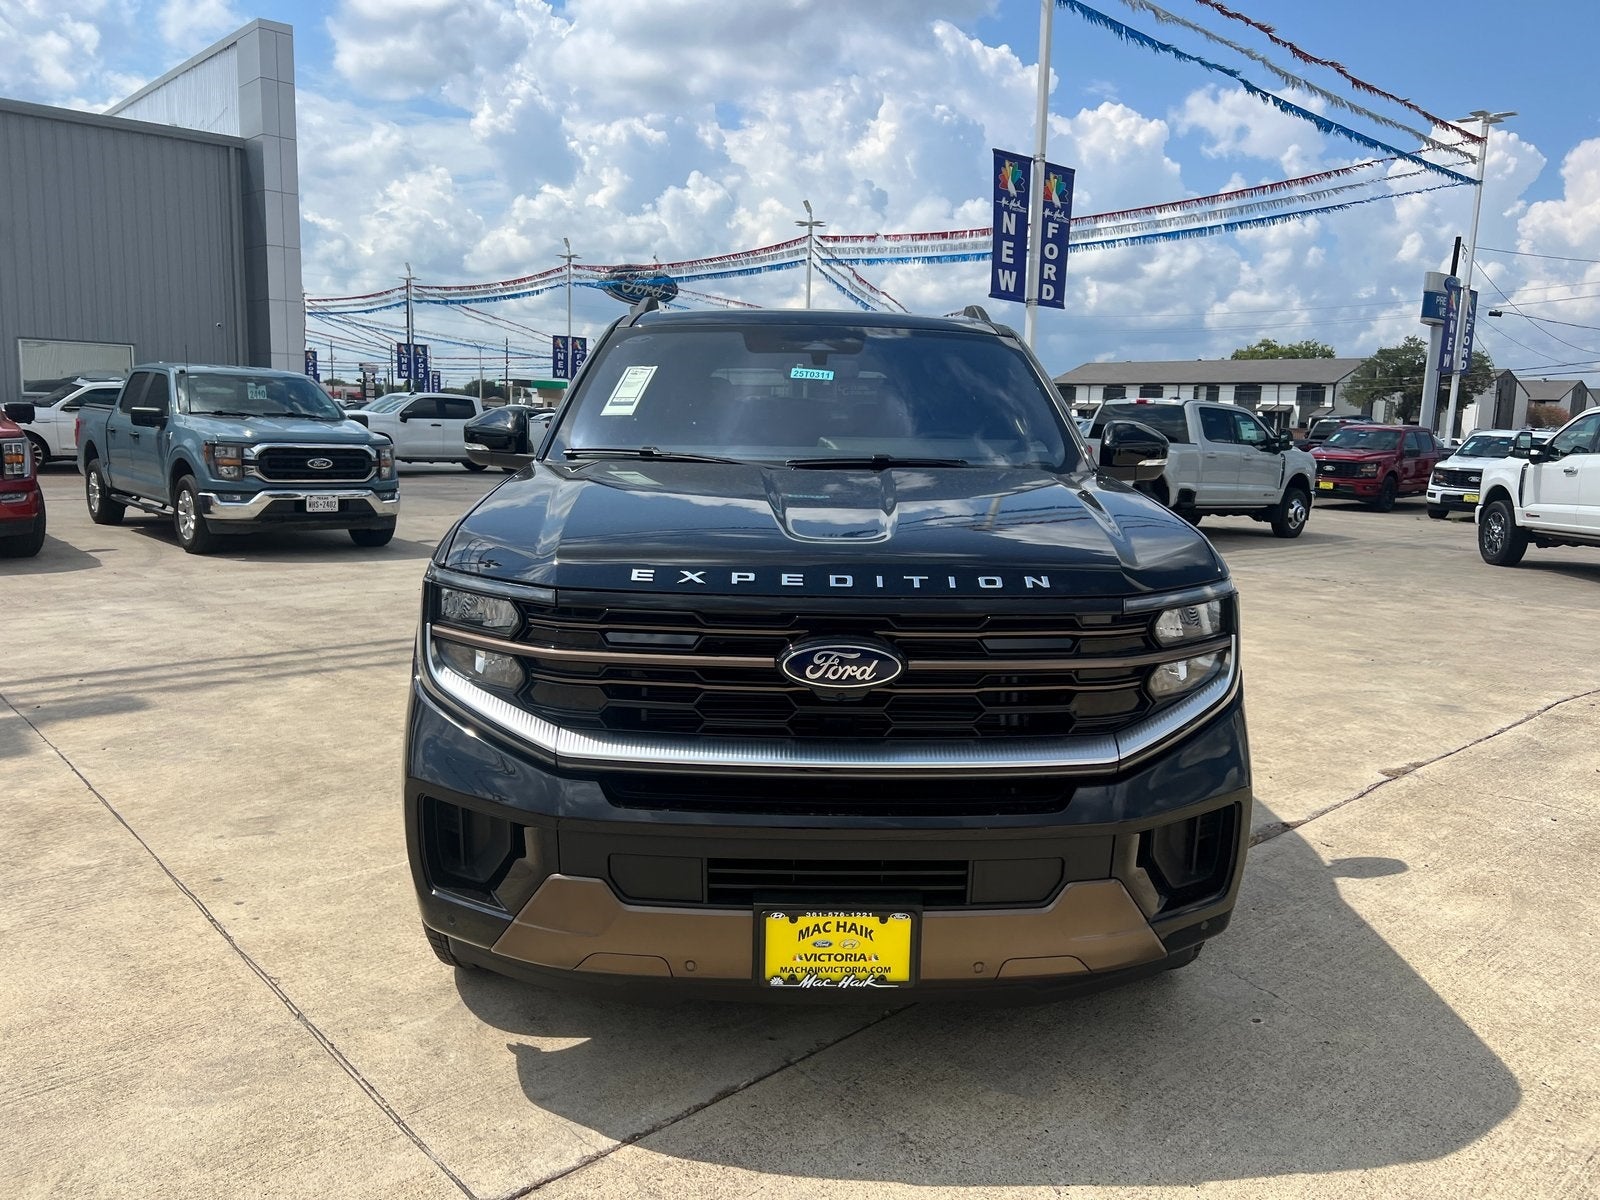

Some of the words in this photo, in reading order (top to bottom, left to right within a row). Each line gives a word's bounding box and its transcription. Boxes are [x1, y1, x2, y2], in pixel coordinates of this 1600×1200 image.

[998, 211, 1017, 292] NEW
[1042, 222, 1058, 300] FORD
[1443, 320, 1456, 368] NEW
[1461, 323, 1471, 370] FORD
[556, 352, 565, 377] NEW
[793, 370, 830, 379] 25T0311
[630, 568, 1051, 589] EXPEDITION
[806, 651, 878, 680] Ford
[797, 921, 832, 942] MAC
[836, 920, 874, 942] HAIK
[803, 953, 868, 962] VICTORIA
[779, 966, 892, 974] MACHAIKVICTORIA.COM
[800, 974, 836, 988] Mac
[838, 974, 884, 989] Haik
